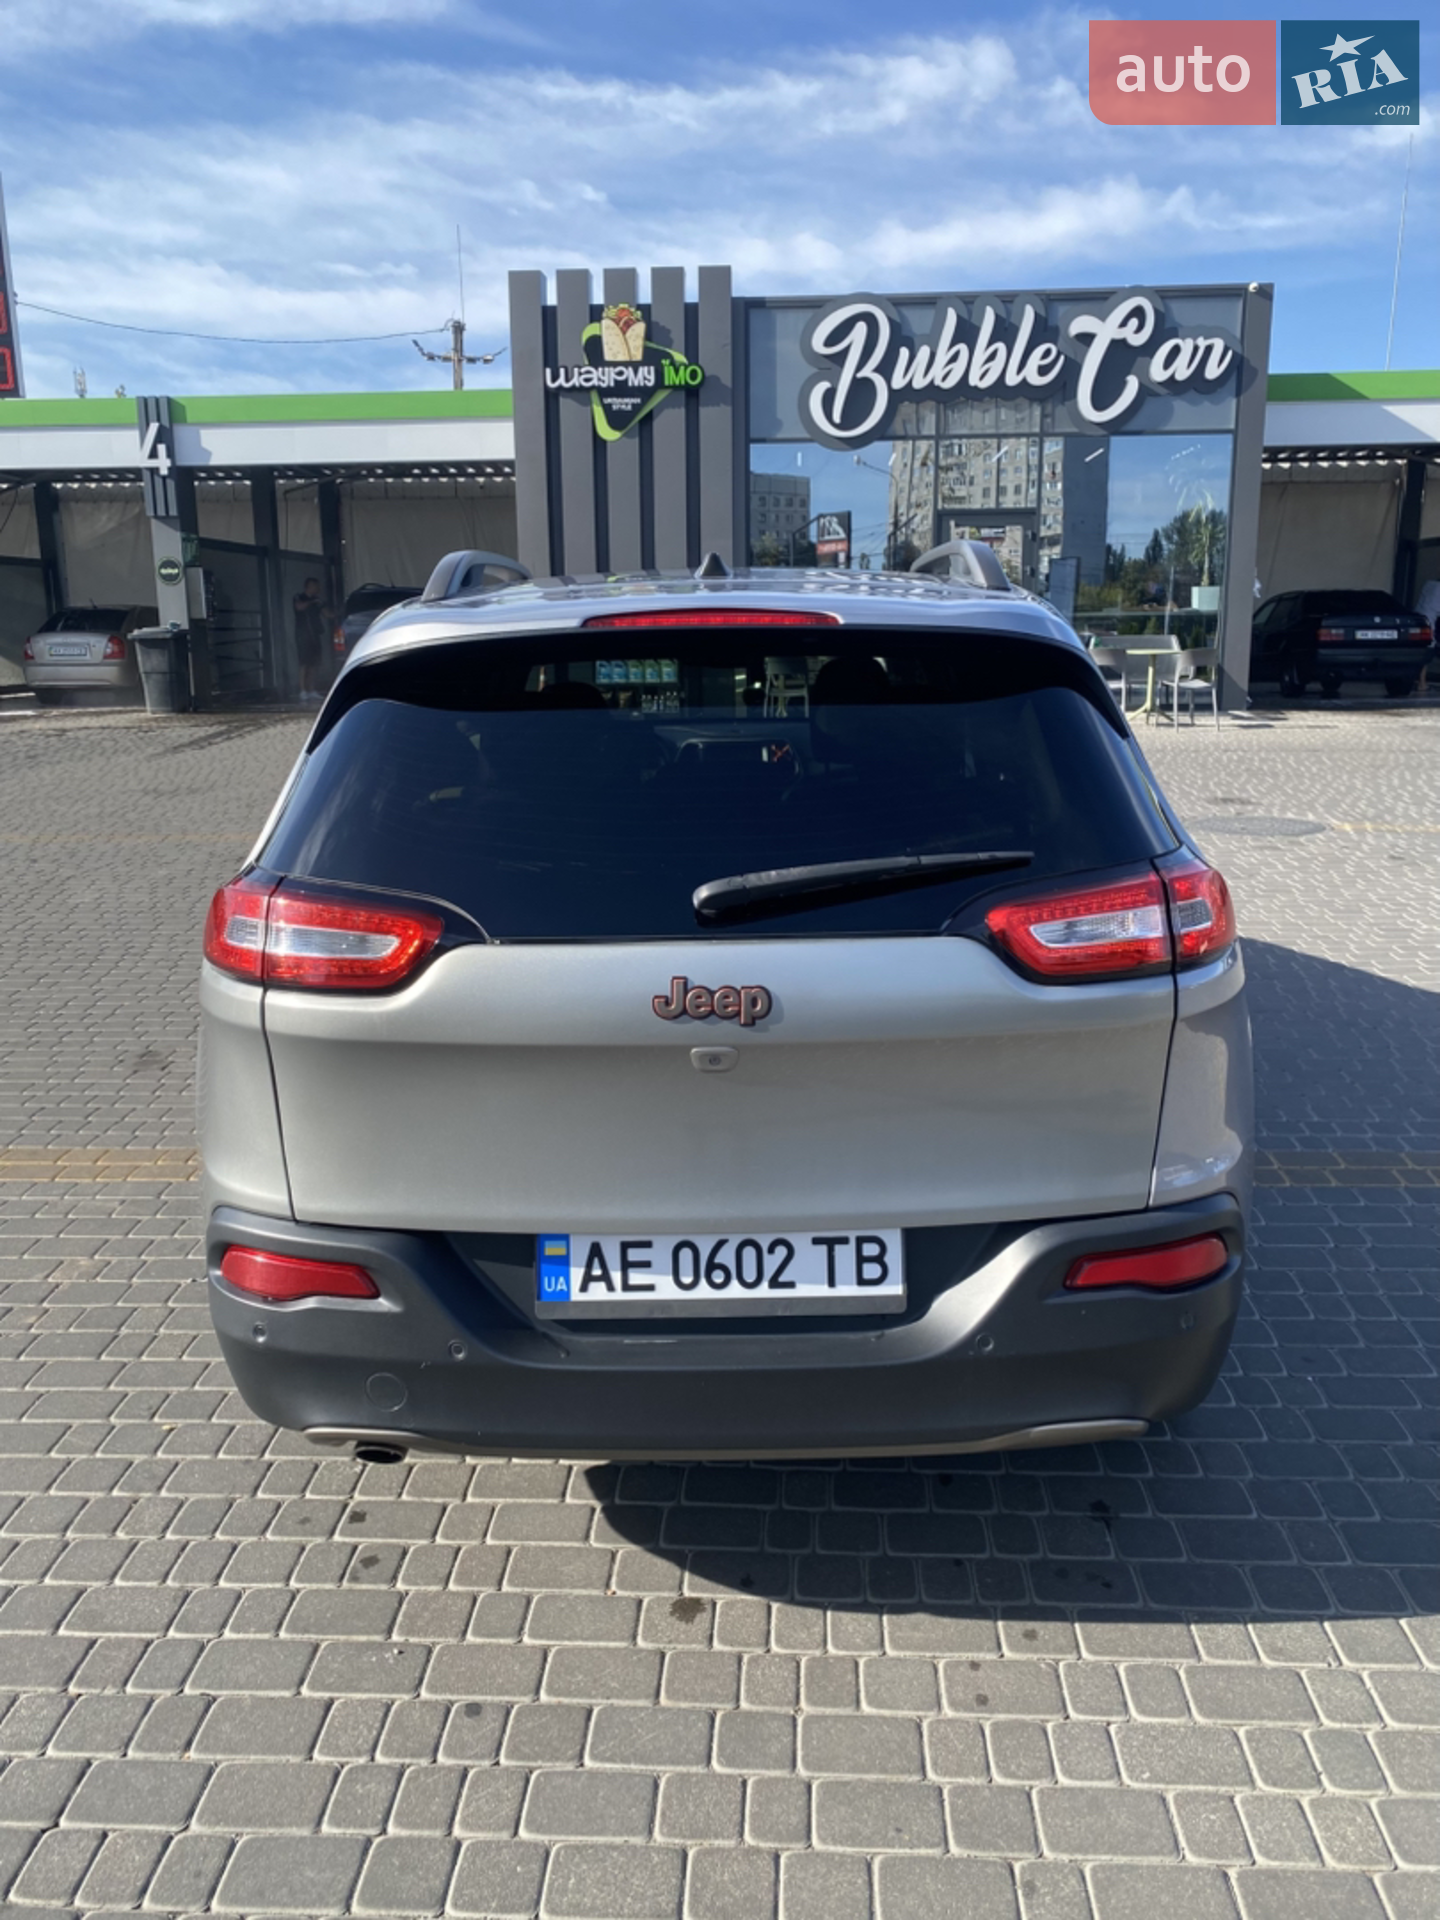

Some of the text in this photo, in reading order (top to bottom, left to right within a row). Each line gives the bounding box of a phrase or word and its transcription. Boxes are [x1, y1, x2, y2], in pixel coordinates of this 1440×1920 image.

[808, 296, 1232, 438] Bubble Car
[138, 422, 171, 476] 4
[651, 975, 772, 1027] Jeep
[544, 1275, 568, 1292] UA
[579, 1235, 889, 1293] AE 0602 TB
